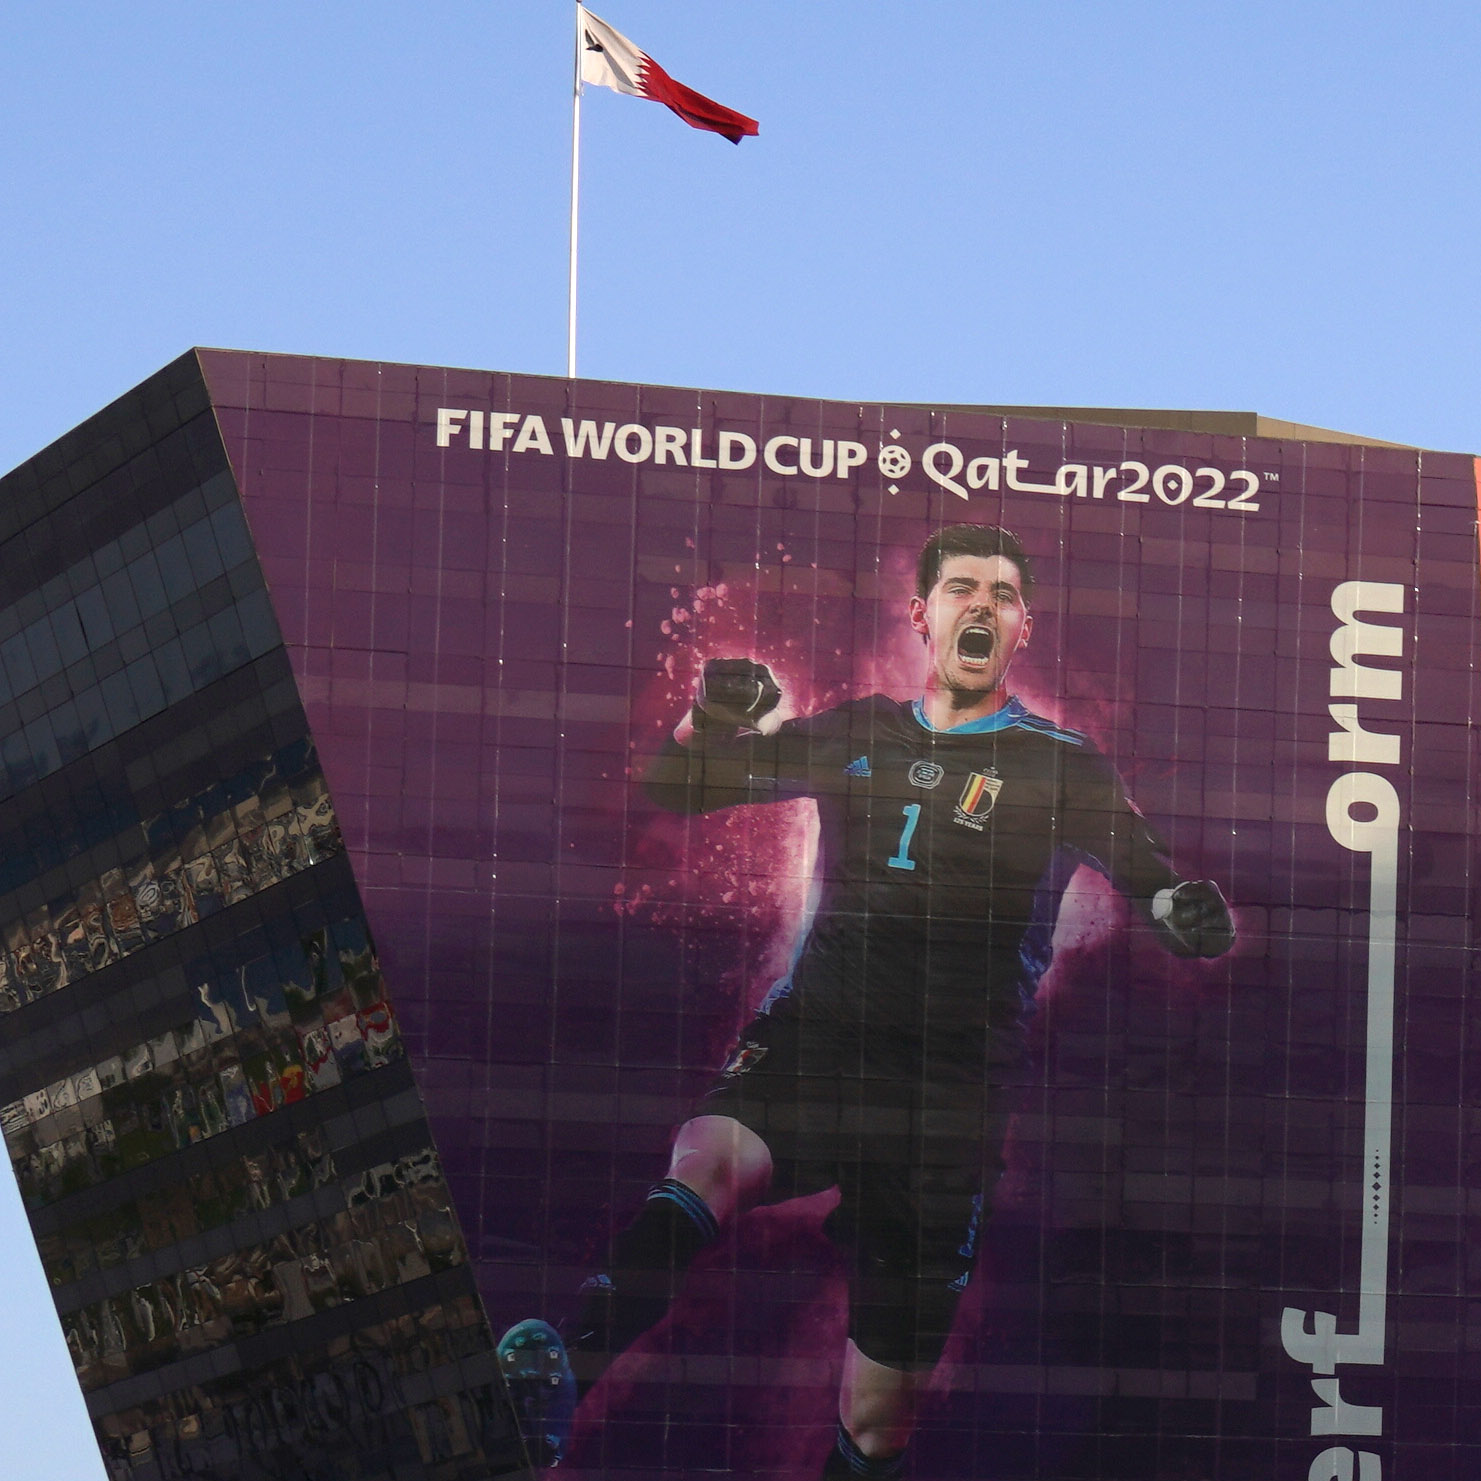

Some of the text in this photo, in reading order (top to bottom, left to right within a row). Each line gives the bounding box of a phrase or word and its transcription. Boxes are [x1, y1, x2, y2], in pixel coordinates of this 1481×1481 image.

[436, 408, 555, 456] FIFA
[561, 417, 757, 470] WORLD
[764, 435, 868, 479] CUP
[887, 803, 922, 871] 1
